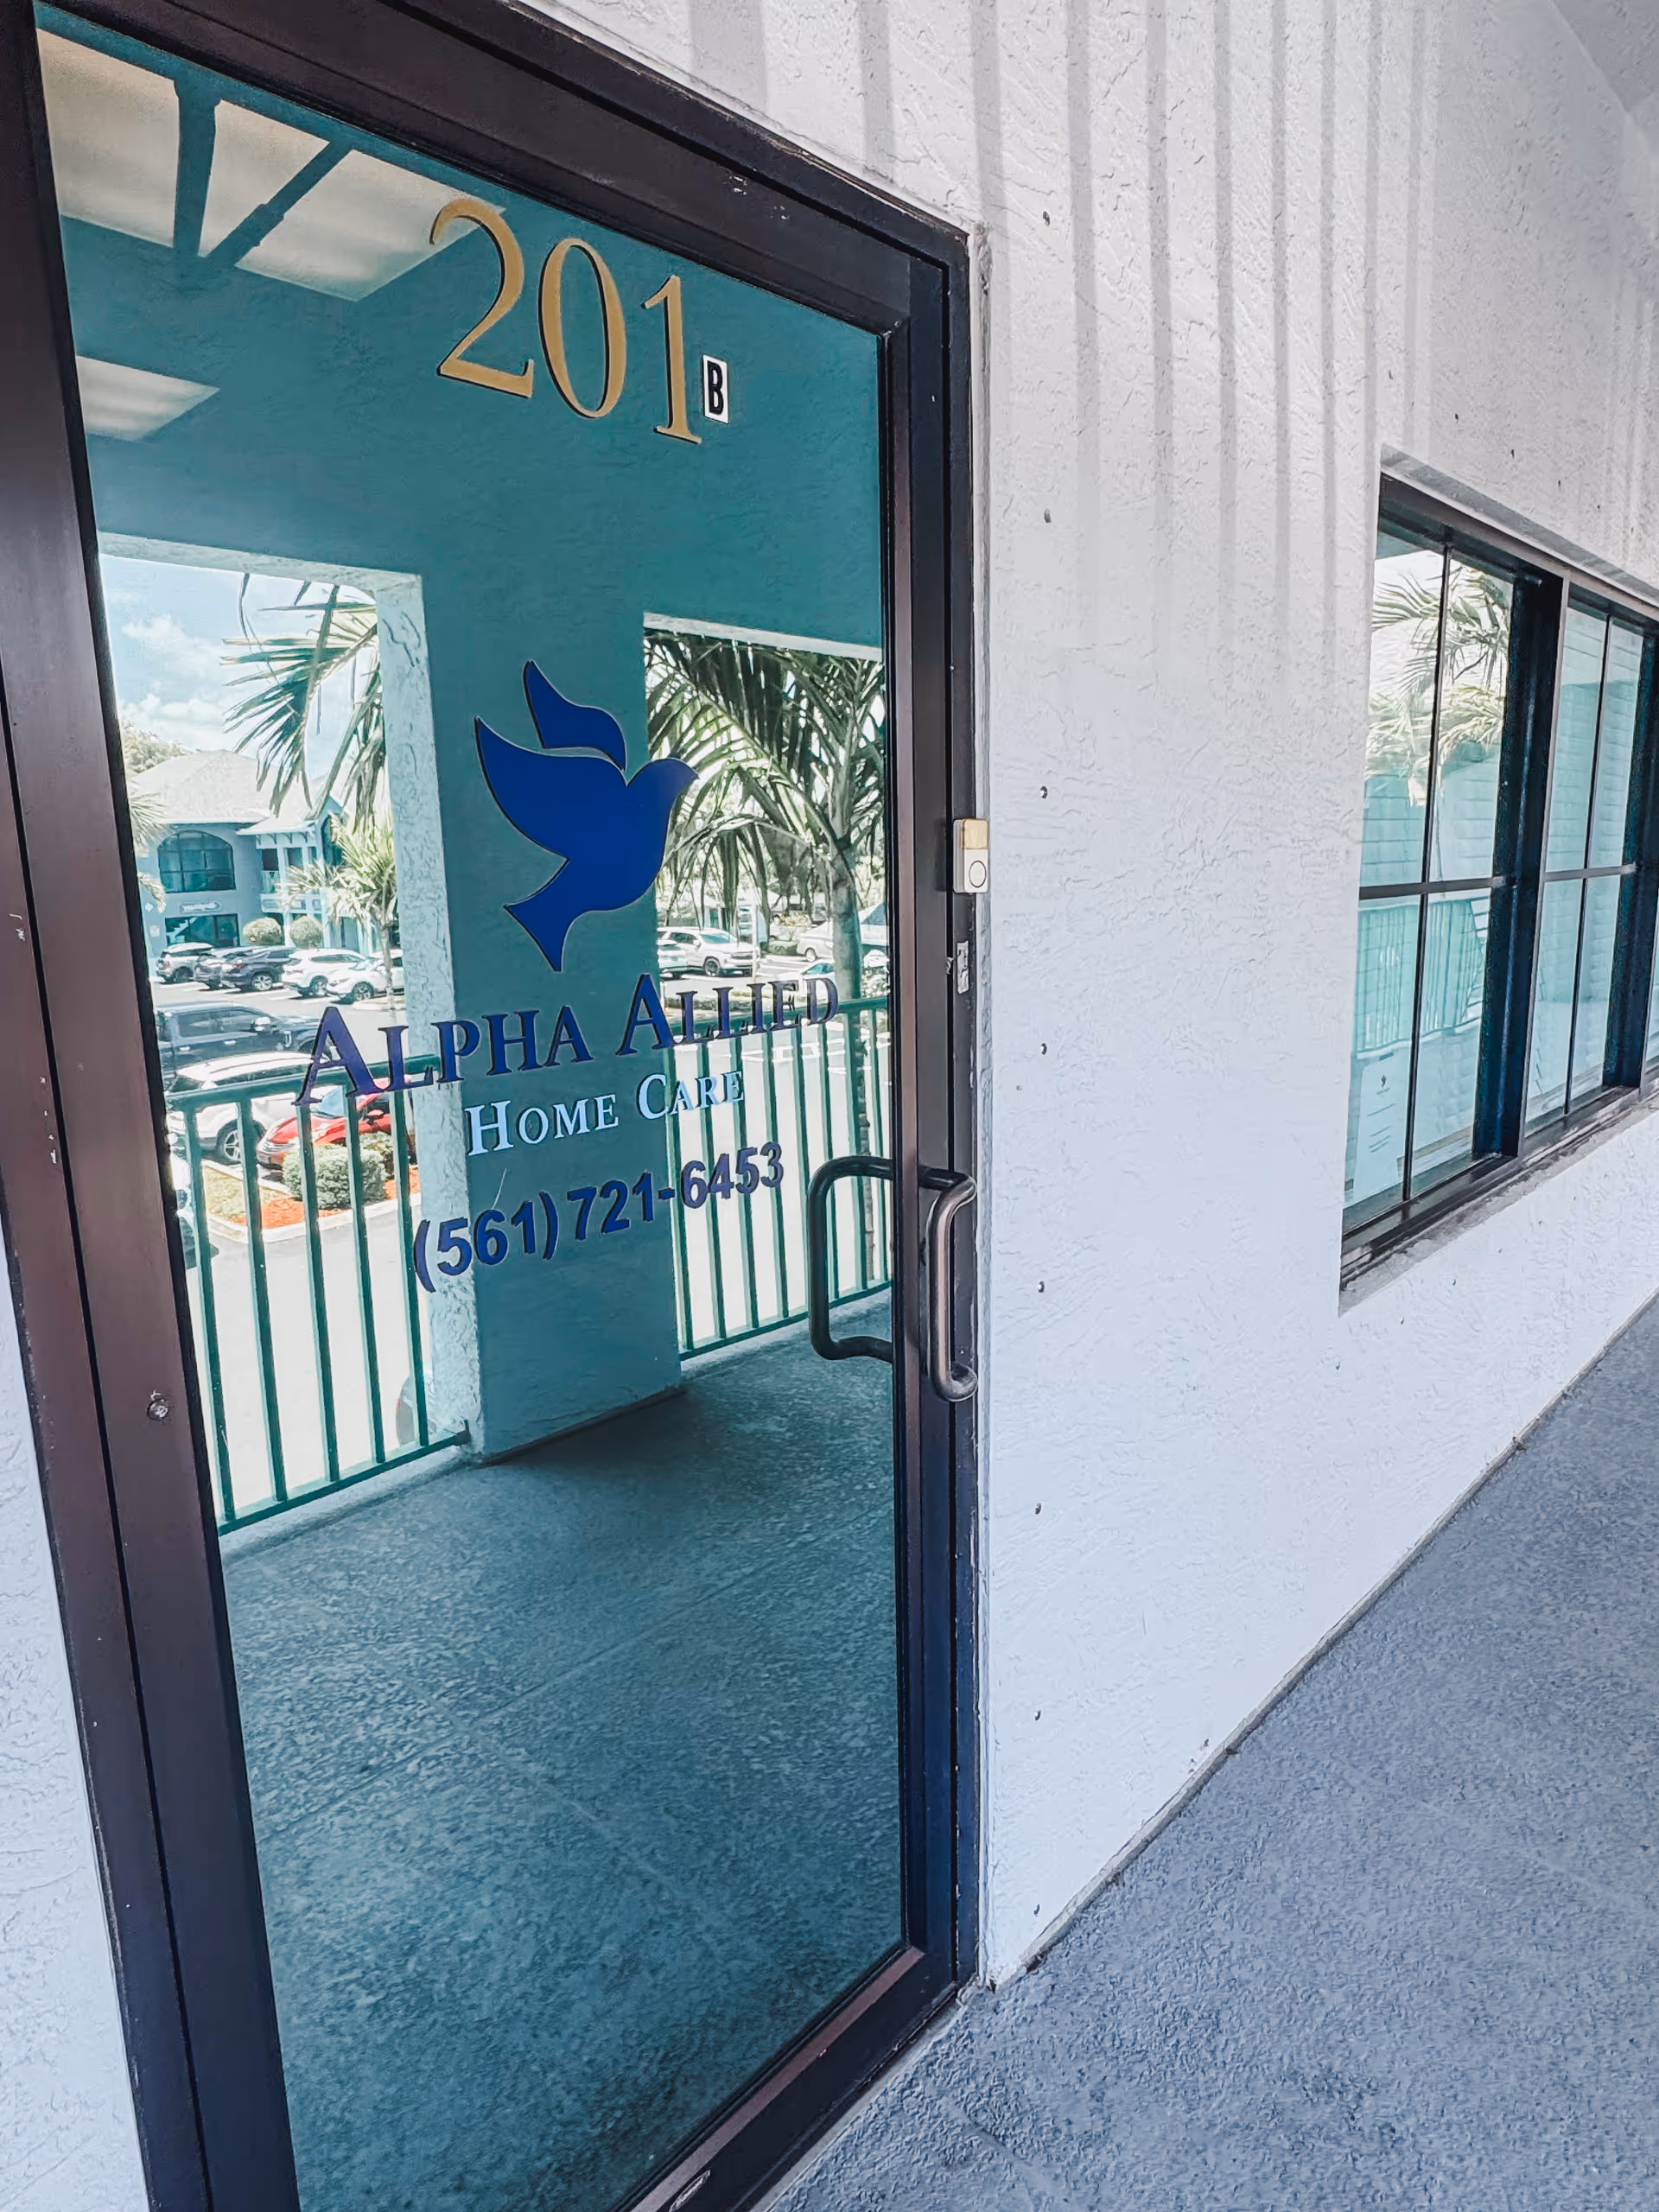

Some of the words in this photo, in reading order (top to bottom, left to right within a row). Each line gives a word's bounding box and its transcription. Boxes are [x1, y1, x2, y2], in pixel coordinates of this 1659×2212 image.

[429, 199, 702, 444] 201
[707, 359, 724, 415] B
[291, 1005, 594, 1106] ALPHA
[615, 973, 838, 1057] ALLIED
[465, 1093, 619, 1157] HOME
[636, 1070, 745, 1121] CARE
